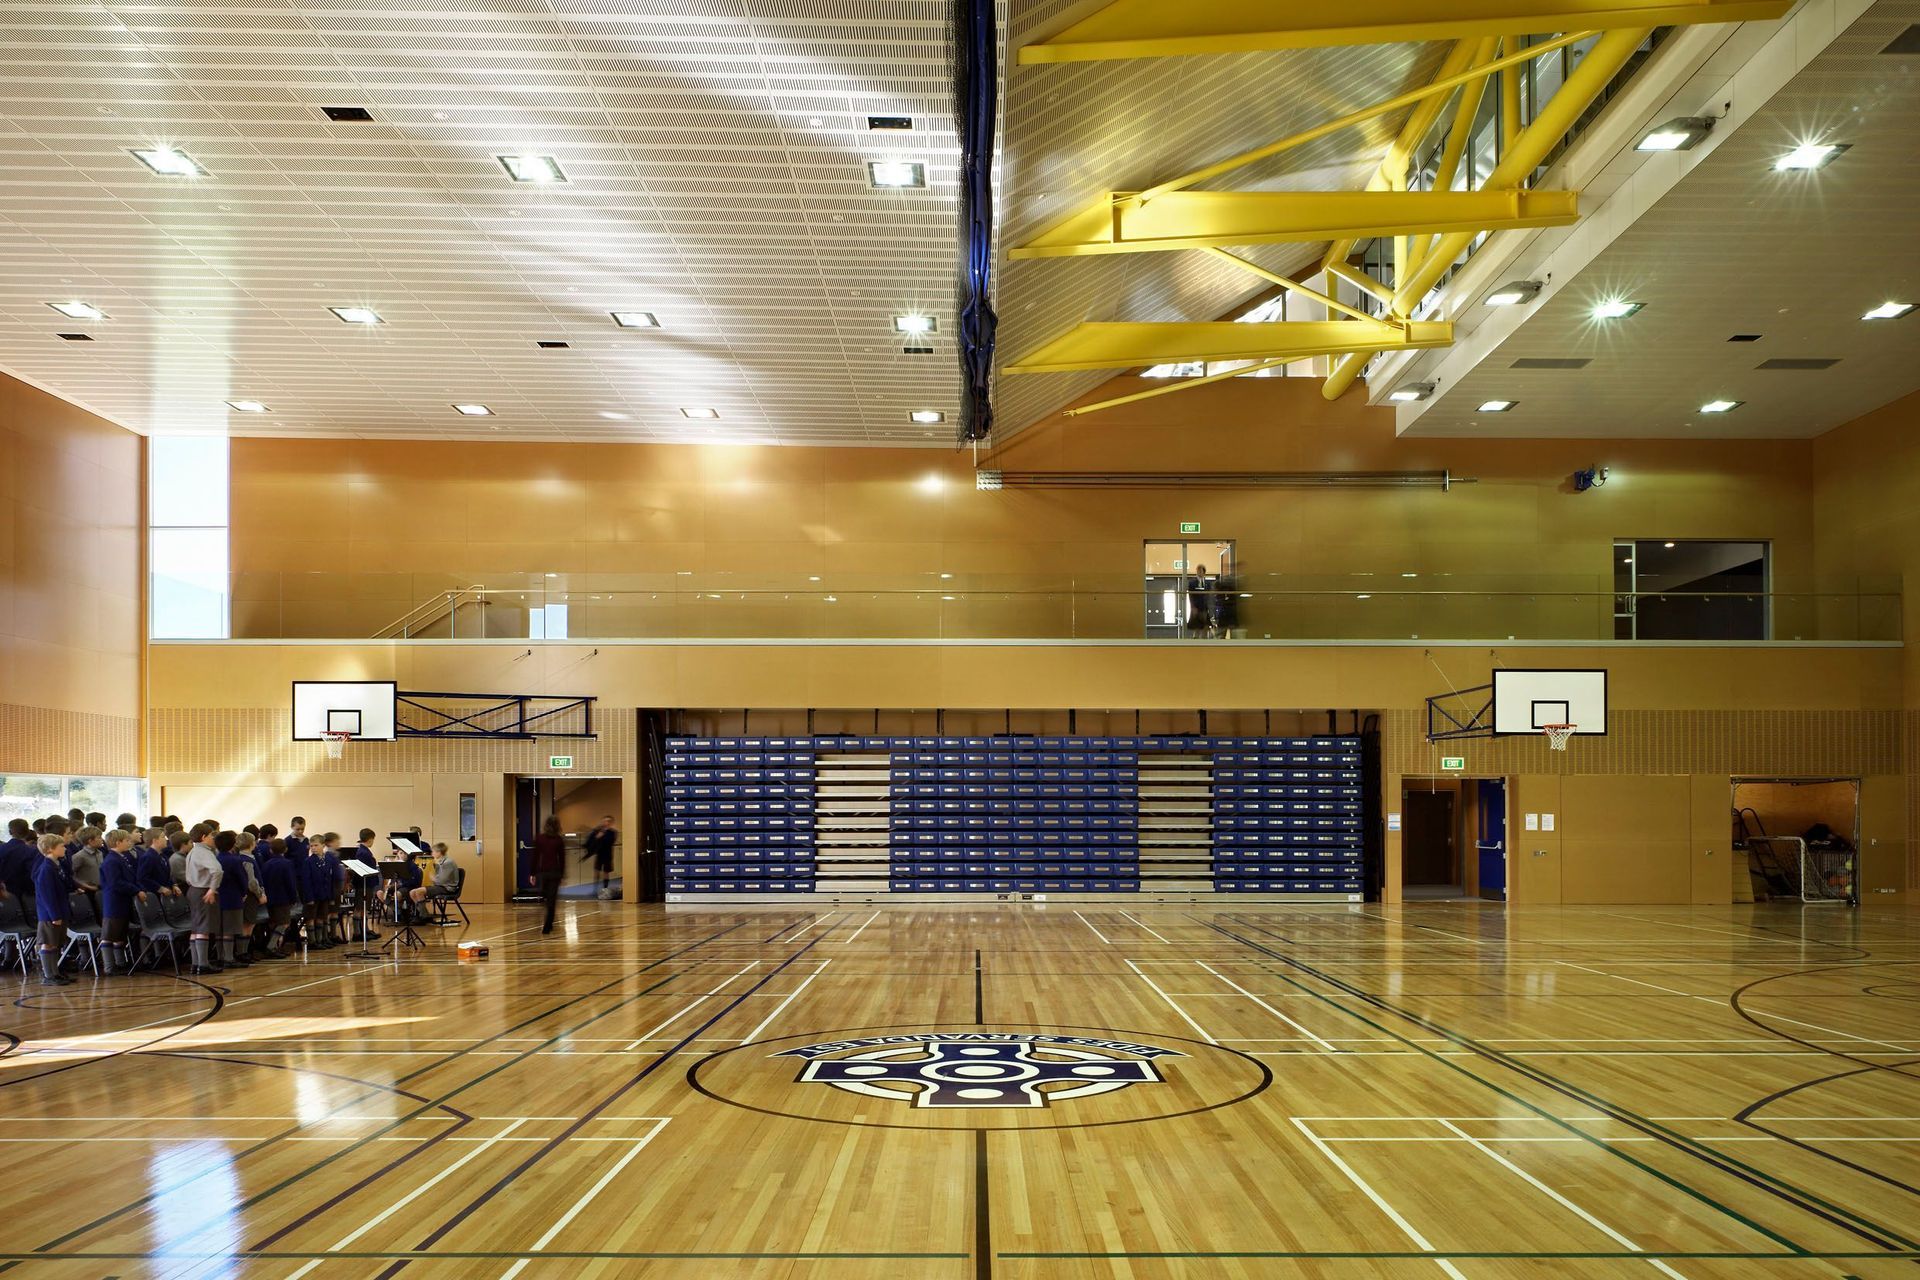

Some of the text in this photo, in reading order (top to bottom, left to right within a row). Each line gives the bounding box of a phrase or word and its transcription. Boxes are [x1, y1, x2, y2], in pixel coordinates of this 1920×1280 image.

[1184, 524, 1196, 532] EXIT
[555, 758, 568, 766] EXIT
[1446, 759, 1459, 768] EXIT
[801, 1033, 1163, 1054] FIDES SERVANDA EST
